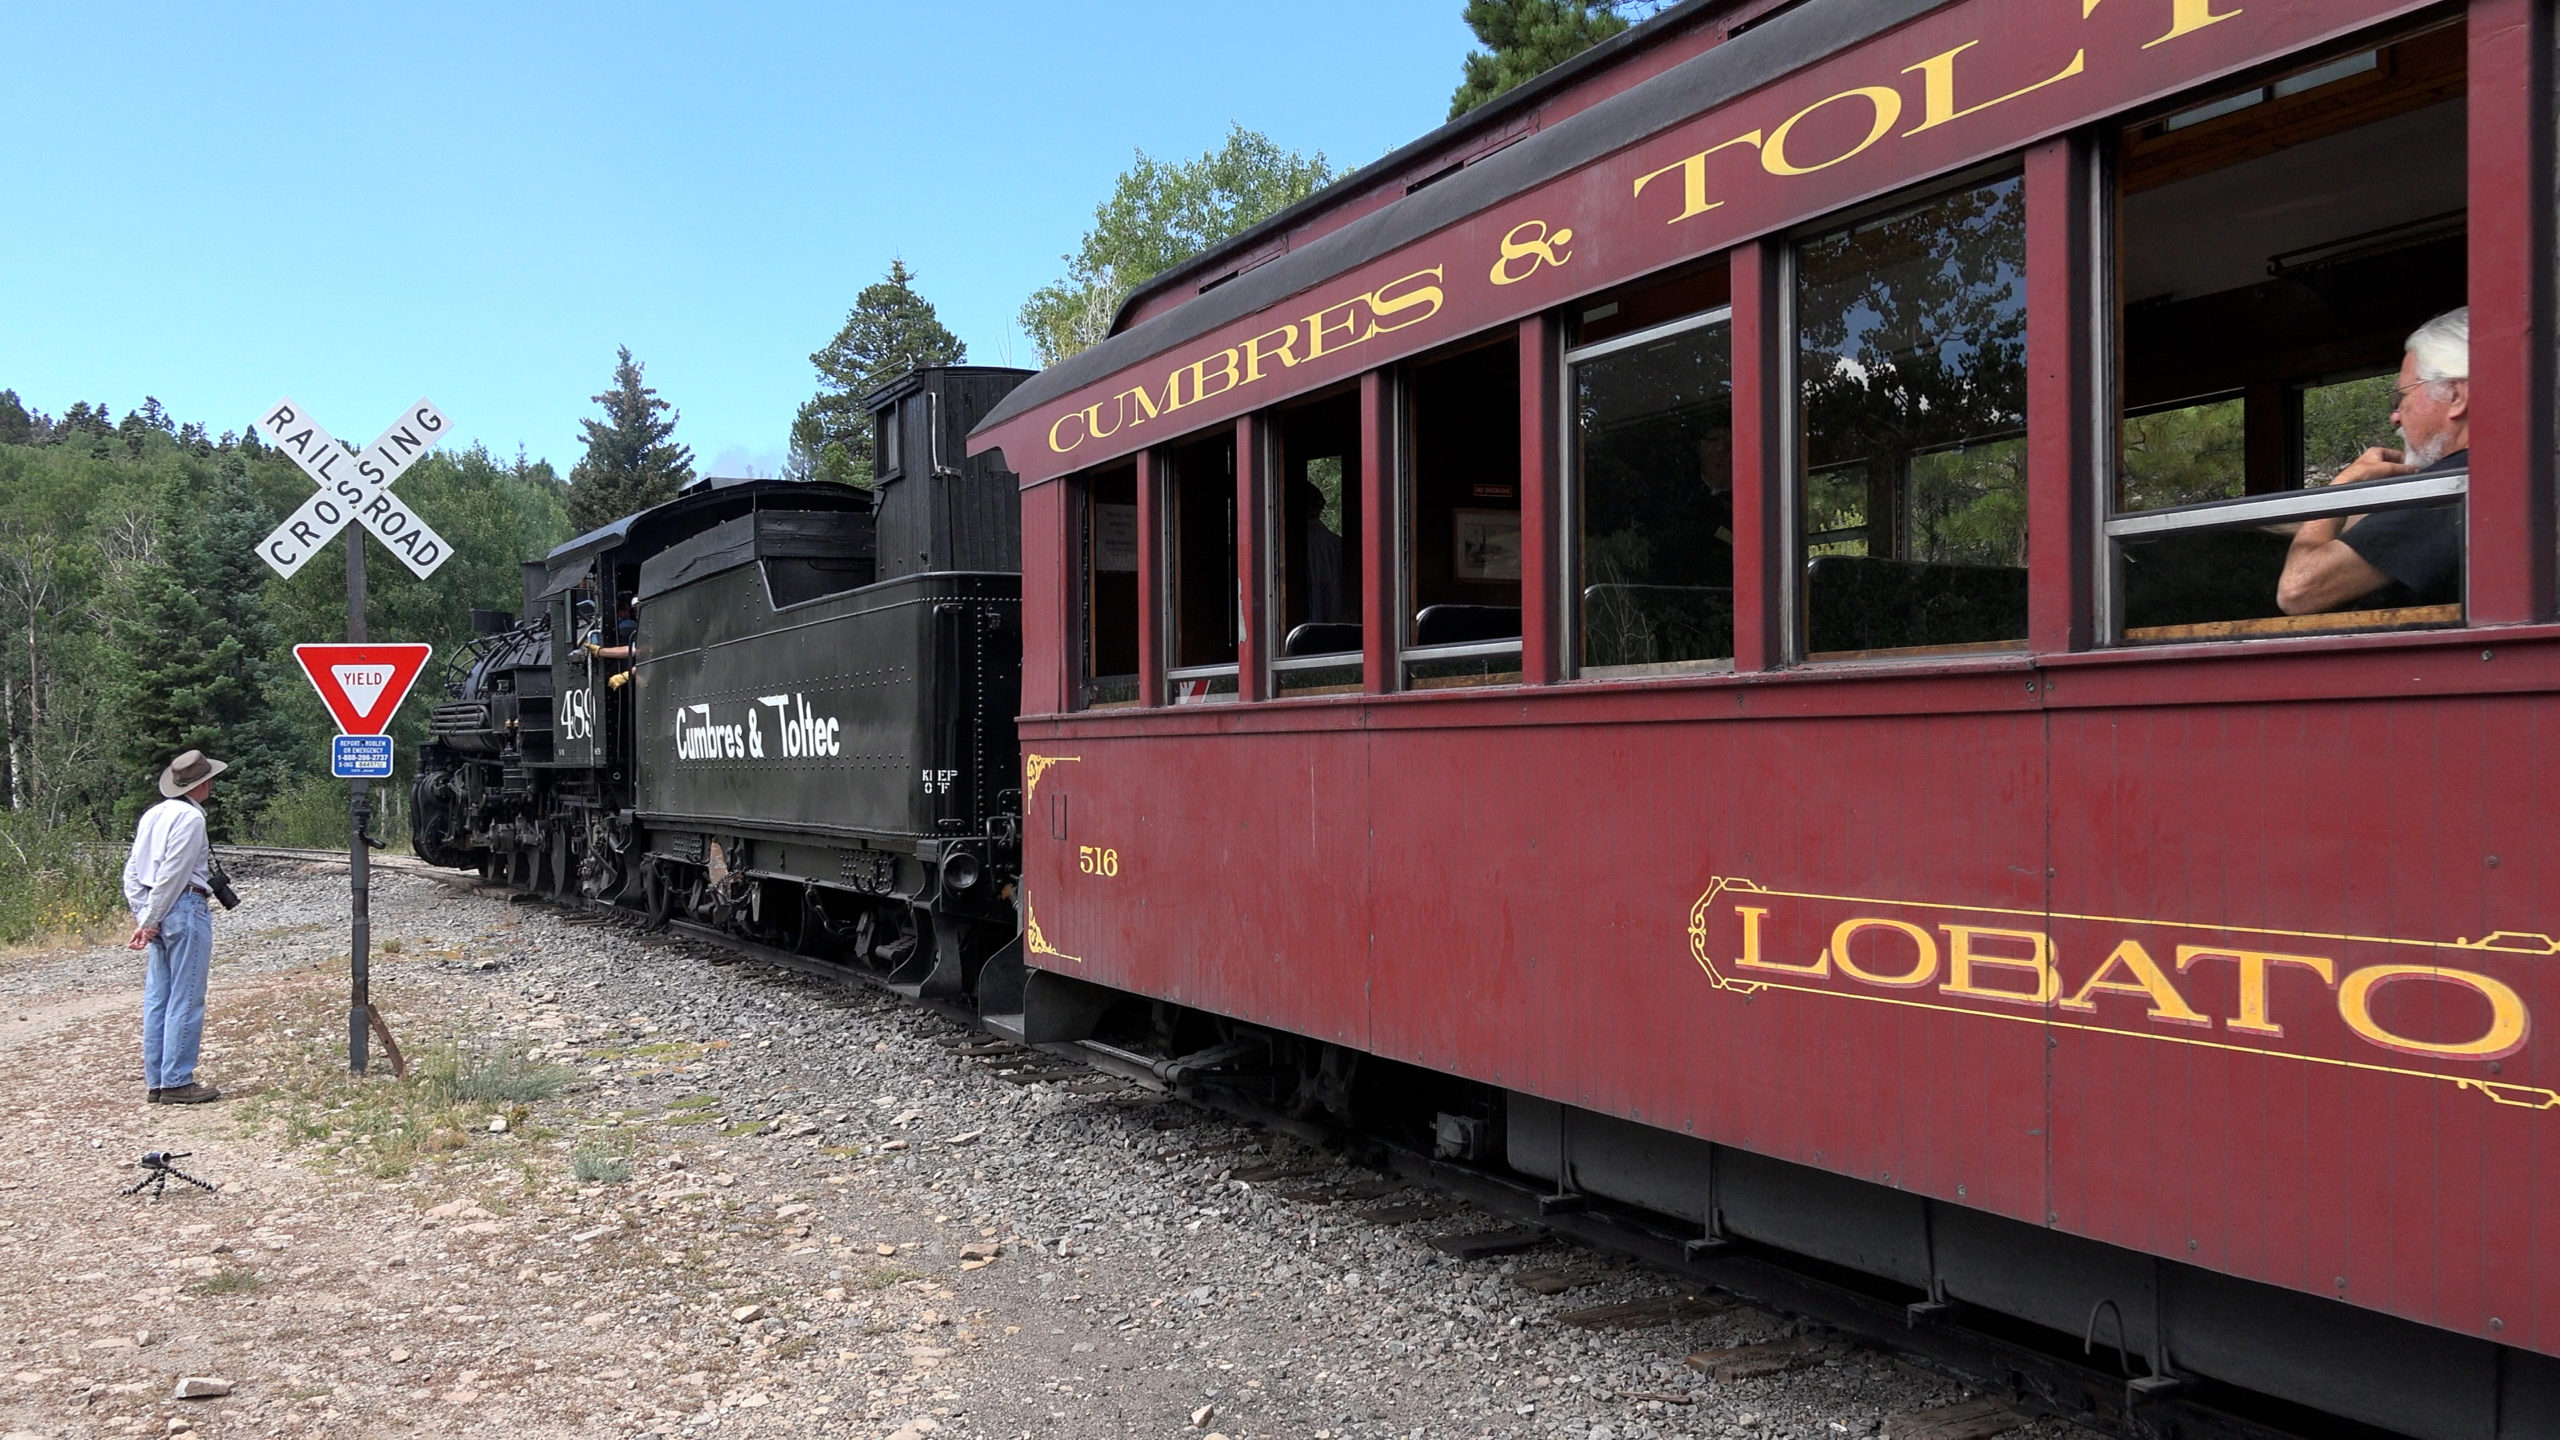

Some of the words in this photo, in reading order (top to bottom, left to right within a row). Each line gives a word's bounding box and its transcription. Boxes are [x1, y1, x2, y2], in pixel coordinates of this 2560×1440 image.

[1048, 263, 1444, 453] CUMBRES
[1489, 220, 1573, 285] &
[266, 405, 340, 482] RAIL
[362, 495, 440, 567] ROAD
[270, 407, 442, 566] CROSSING
[343, 672, 382, 685] YIELD
[560, 687, 597, 740] 489
[676, 703, 745, 760] Cumbres
[748, 708, 764, 758] &
[756, 692, 840, 758] Toltec
[924, 782, 950, 794] OF
[1080, 845, 1118, 877] 516
[1734, 905, 2531, 1062] LOBATO
